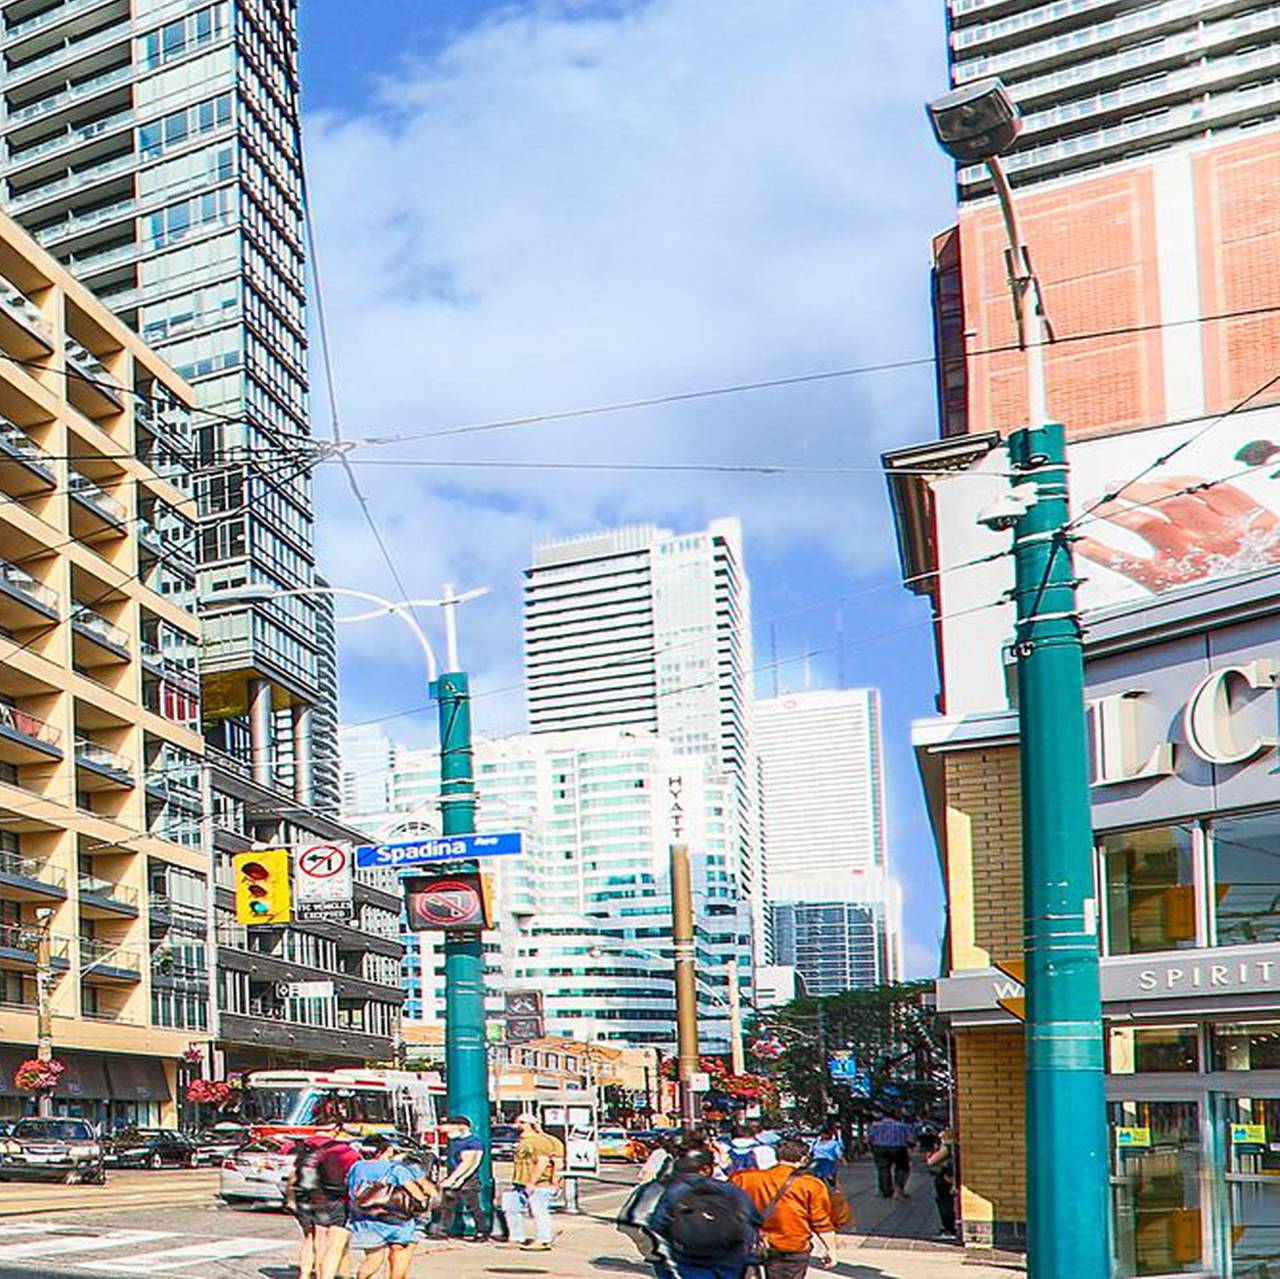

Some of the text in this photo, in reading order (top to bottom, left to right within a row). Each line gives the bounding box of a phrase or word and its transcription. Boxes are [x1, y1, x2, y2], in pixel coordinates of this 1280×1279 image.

[669, 776, 683, 838] HYATT
[376, 835, 498, 864] Spadina Ave
